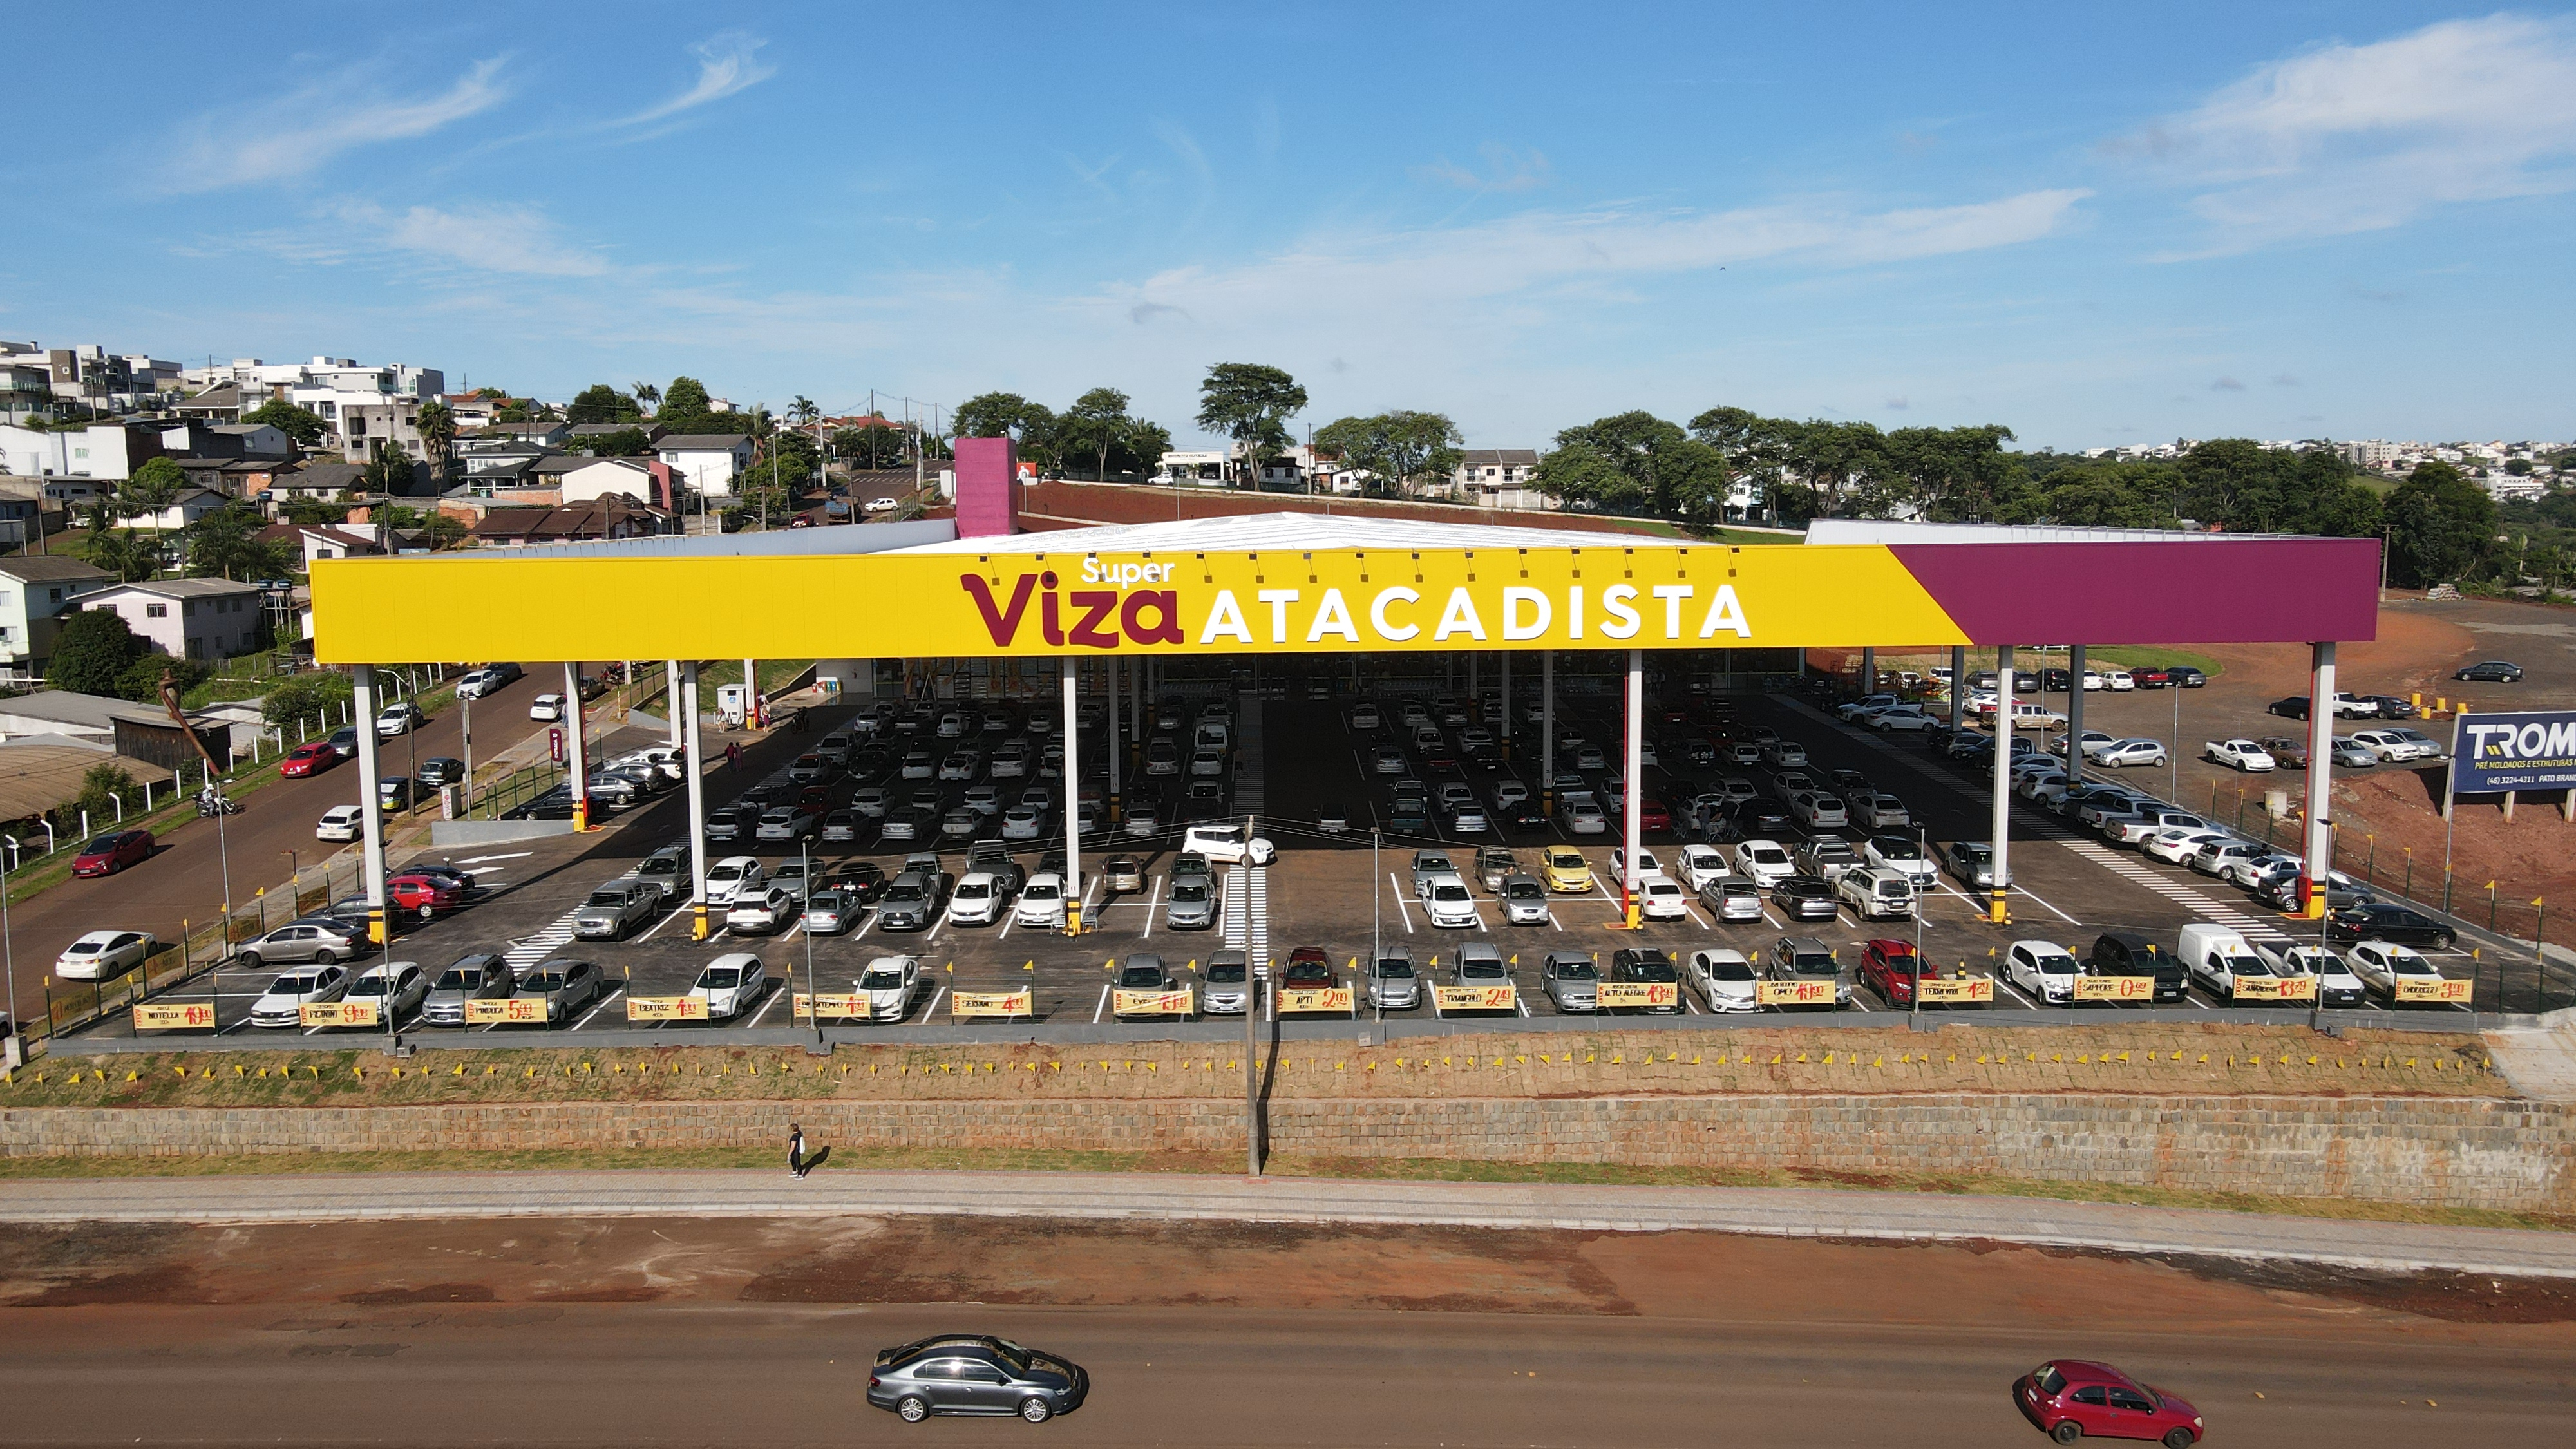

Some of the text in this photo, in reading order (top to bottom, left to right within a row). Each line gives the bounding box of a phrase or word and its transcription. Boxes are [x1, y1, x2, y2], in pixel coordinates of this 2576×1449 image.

[1081, 556, 1176, 589] Super
[960, 570, 1752, 649] Viza ATACADISTA
[2475, 759, 2488, 770] PRÉ
[2489, 760, 2526, 769] MOLDADOS
[2532, 759, 2573, 768] ESTRUTURAS
[2487, 775, 2535, 786] (46) 3224-4311
[2539, 774, 2555, 782] PATO
